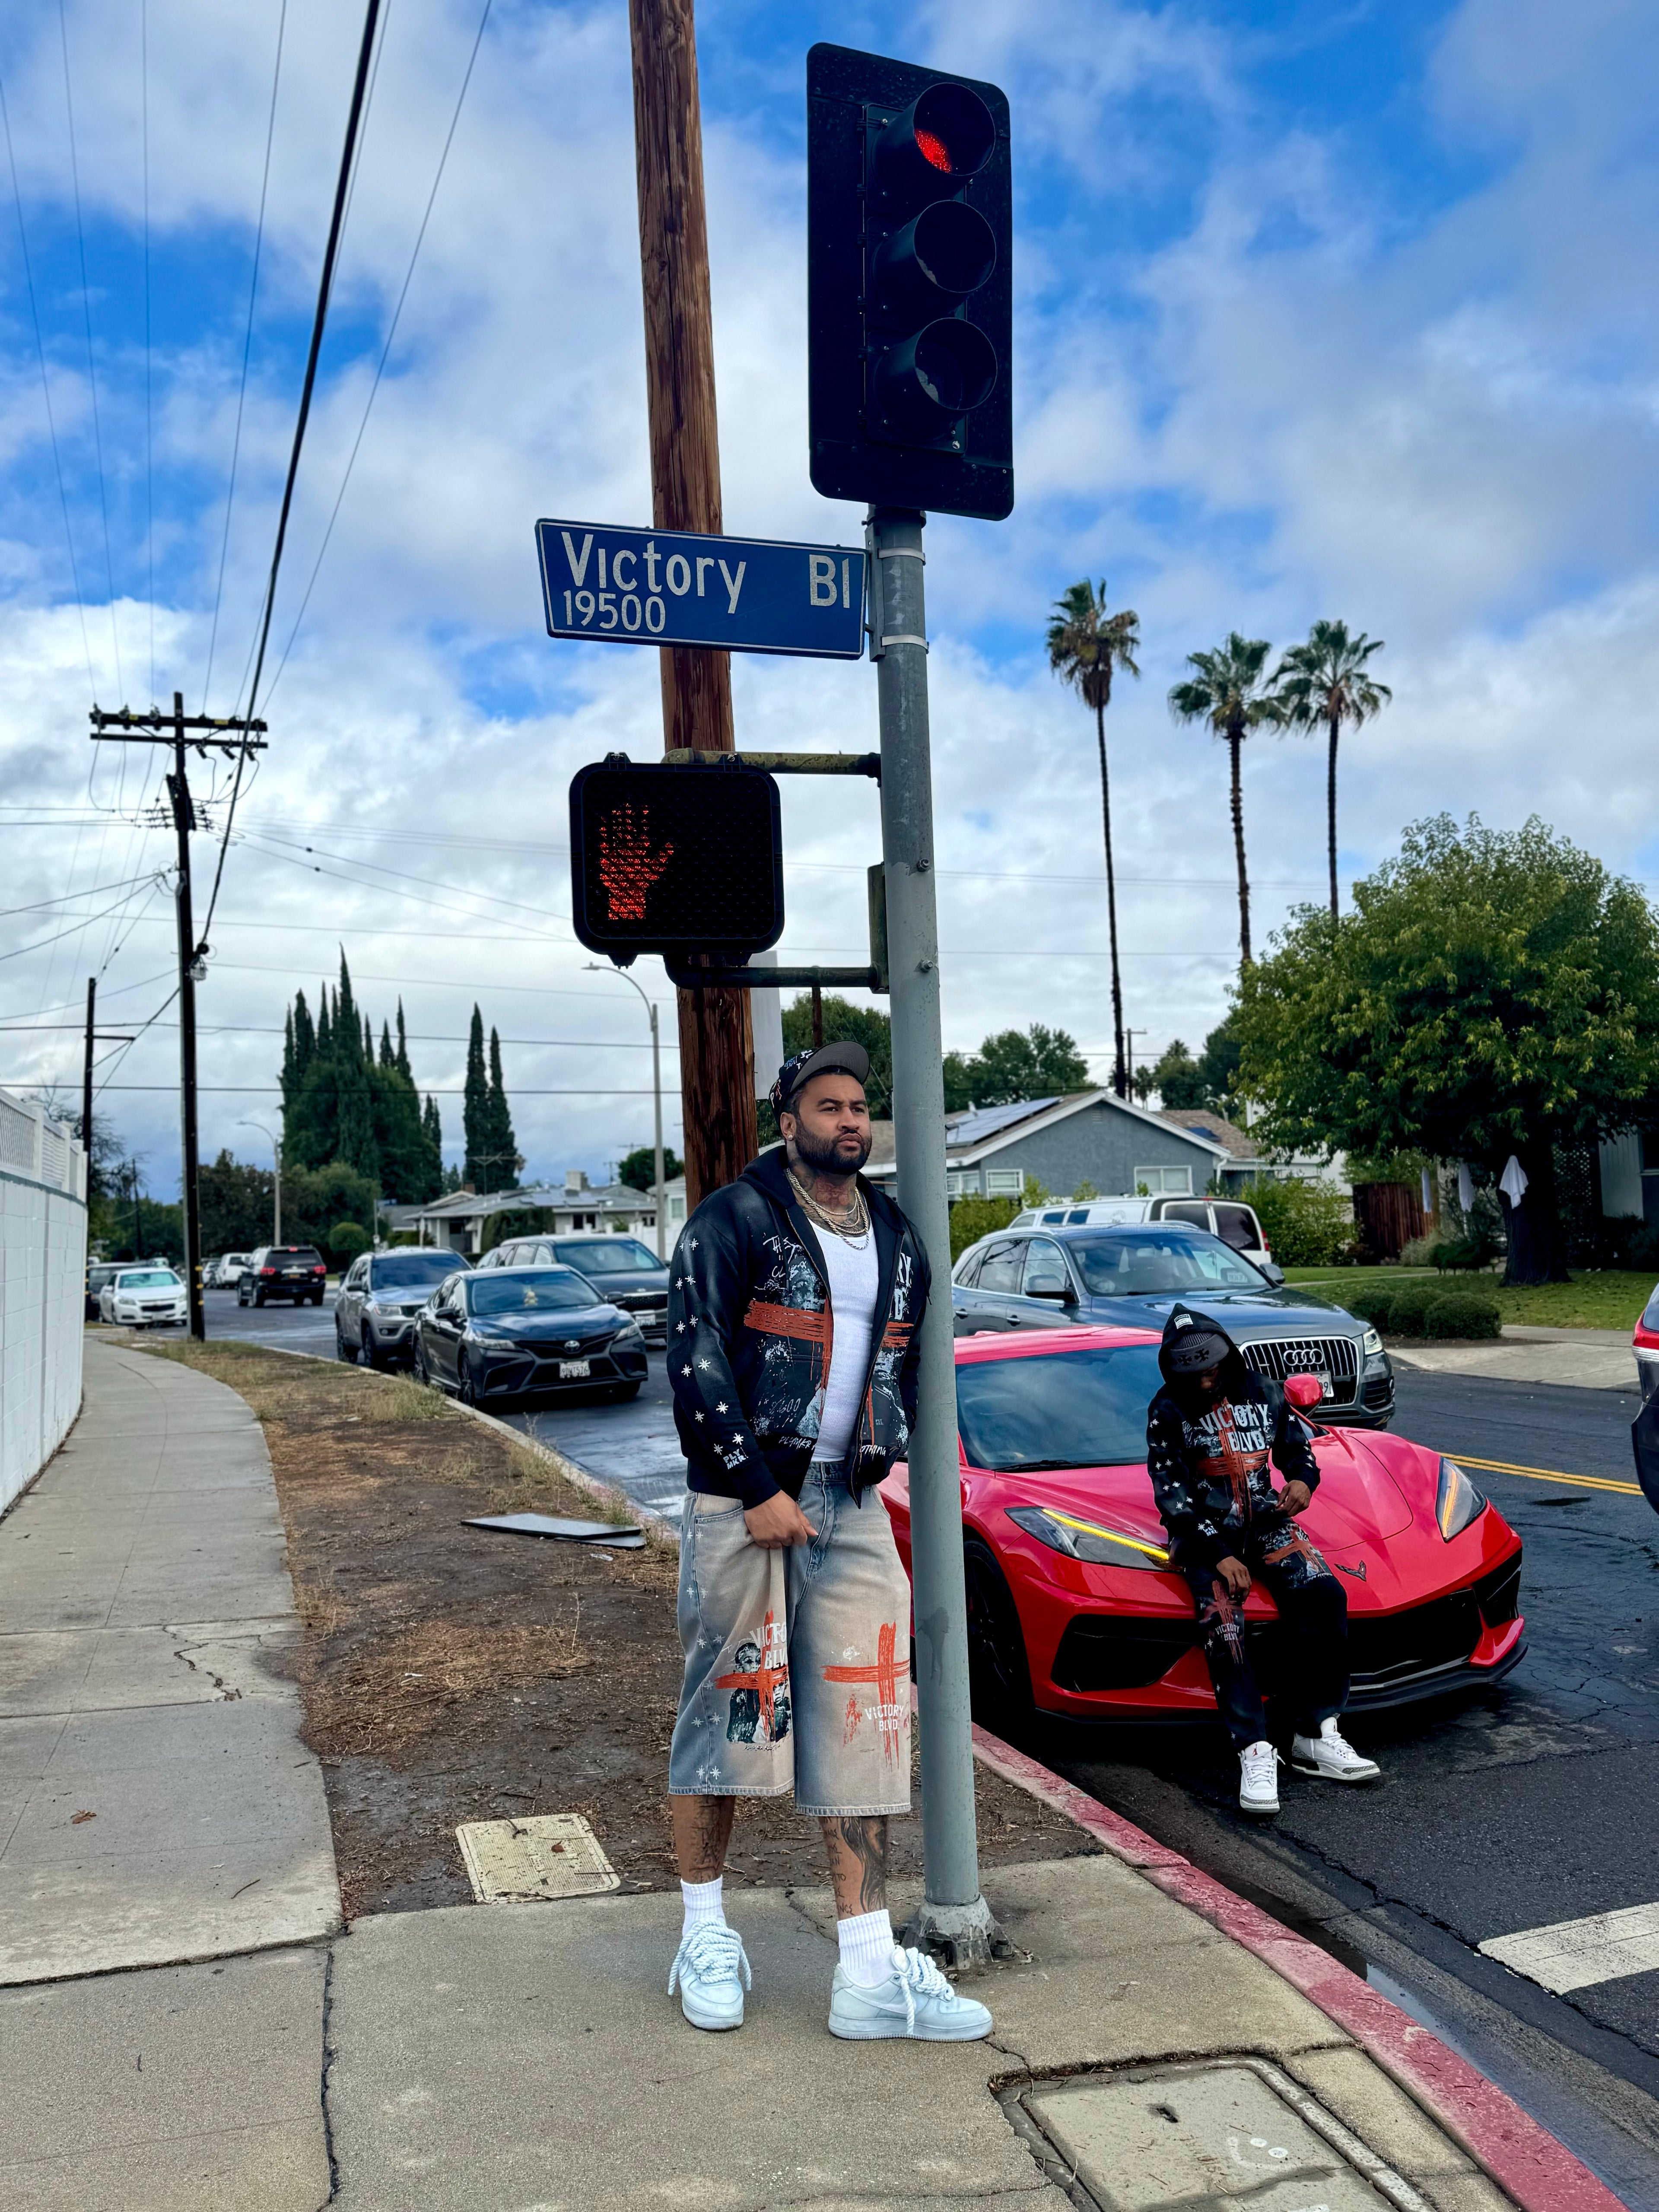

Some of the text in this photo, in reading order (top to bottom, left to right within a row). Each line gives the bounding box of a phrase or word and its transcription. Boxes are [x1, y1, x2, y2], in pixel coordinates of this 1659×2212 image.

[561, 531, 746, 614] Victory
[563, 590, 666, 633] 19500
[1199, 1404, 1268, 1434] VICTORY
[723, 1448, 740, 1463] PLY
[727, 1455, 746, 1469] MKR
[1215, 1623, 1240, 1635] VICTORY
[864, 1704, 904, 1720] VICTORY
